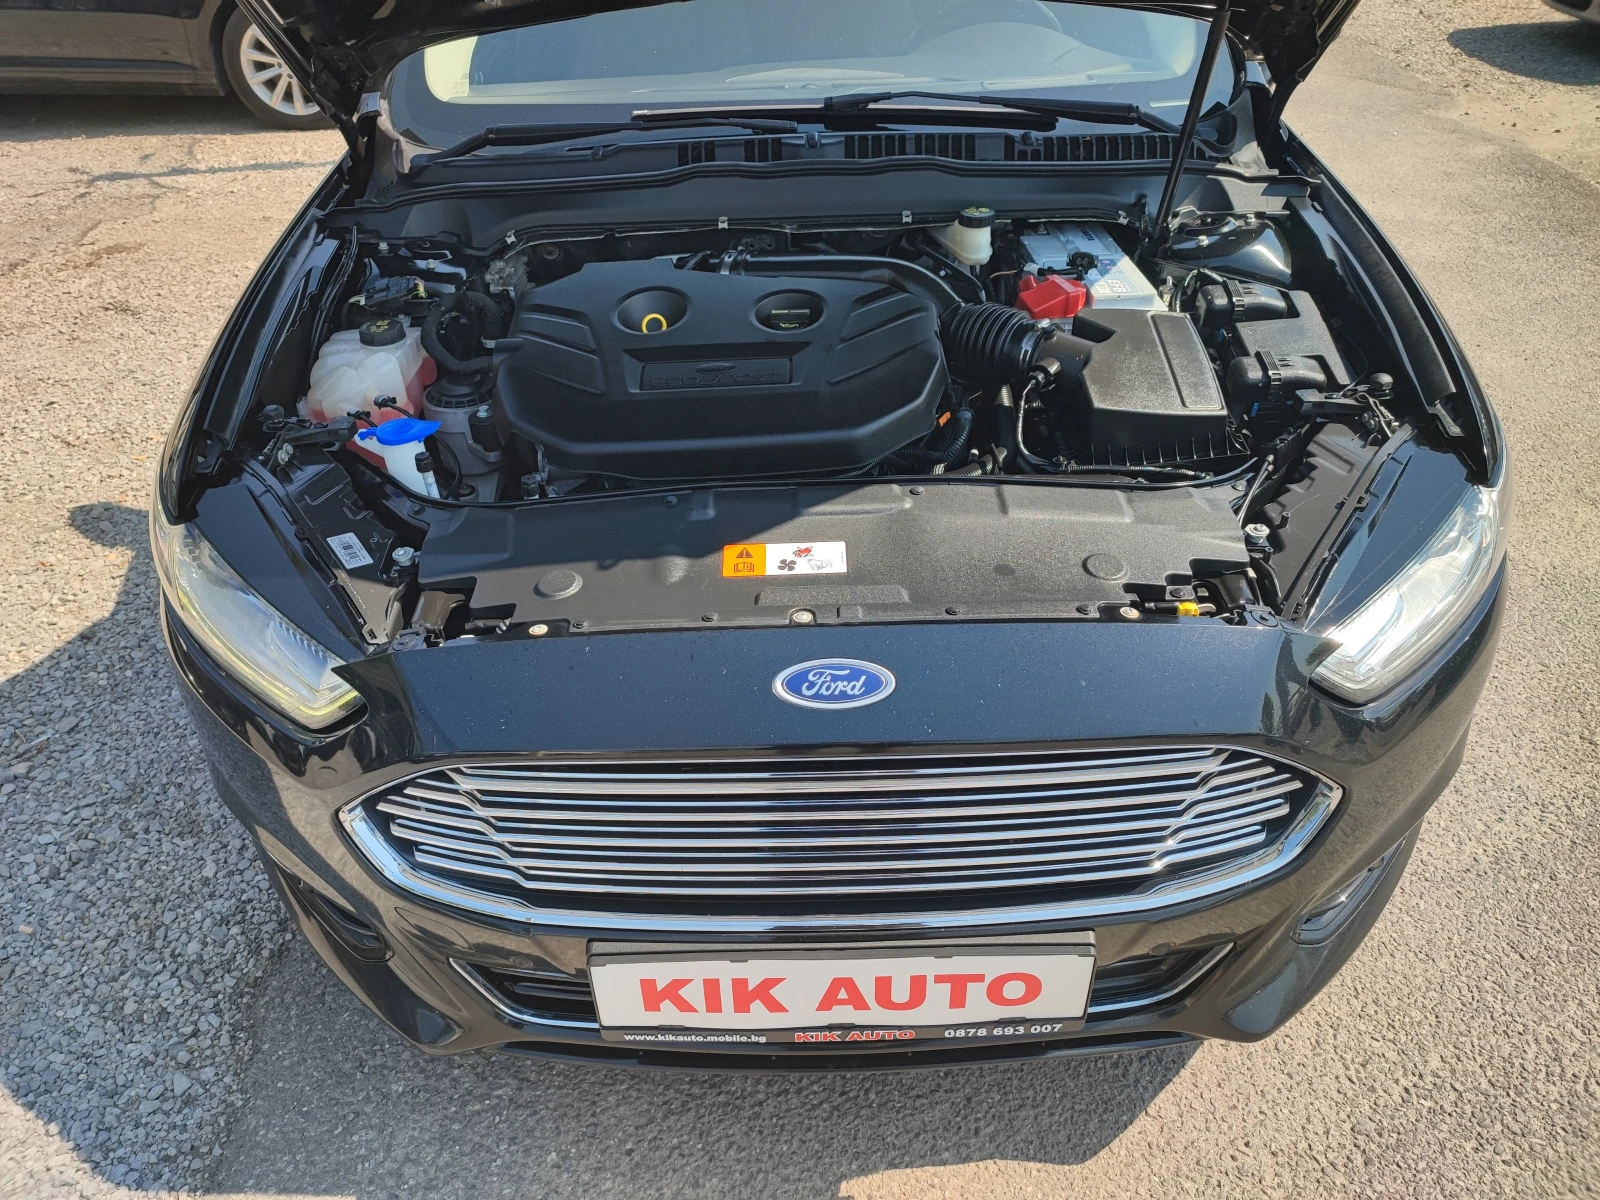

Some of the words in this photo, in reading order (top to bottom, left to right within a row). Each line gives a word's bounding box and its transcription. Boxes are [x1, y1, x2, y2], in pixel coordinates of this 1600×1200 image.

[1107, 279, 1127, 293] EFB
[801, 669, 867, 696] Ford
[639, 977, 790, 1014] KIK
[815, 972, 1043, 1012] AUTO
[623, 1032, 767, 1043] www.kikauto.mobile.bg
[794, 1031, 842, 1042] KIK
[845, 1029, 916, 1042] AUTO
[944, 1028, 988, 1038] 0878
[992, 1026, 1025, 1037] 693
[1030, 1023, 1063, 1034] 007
